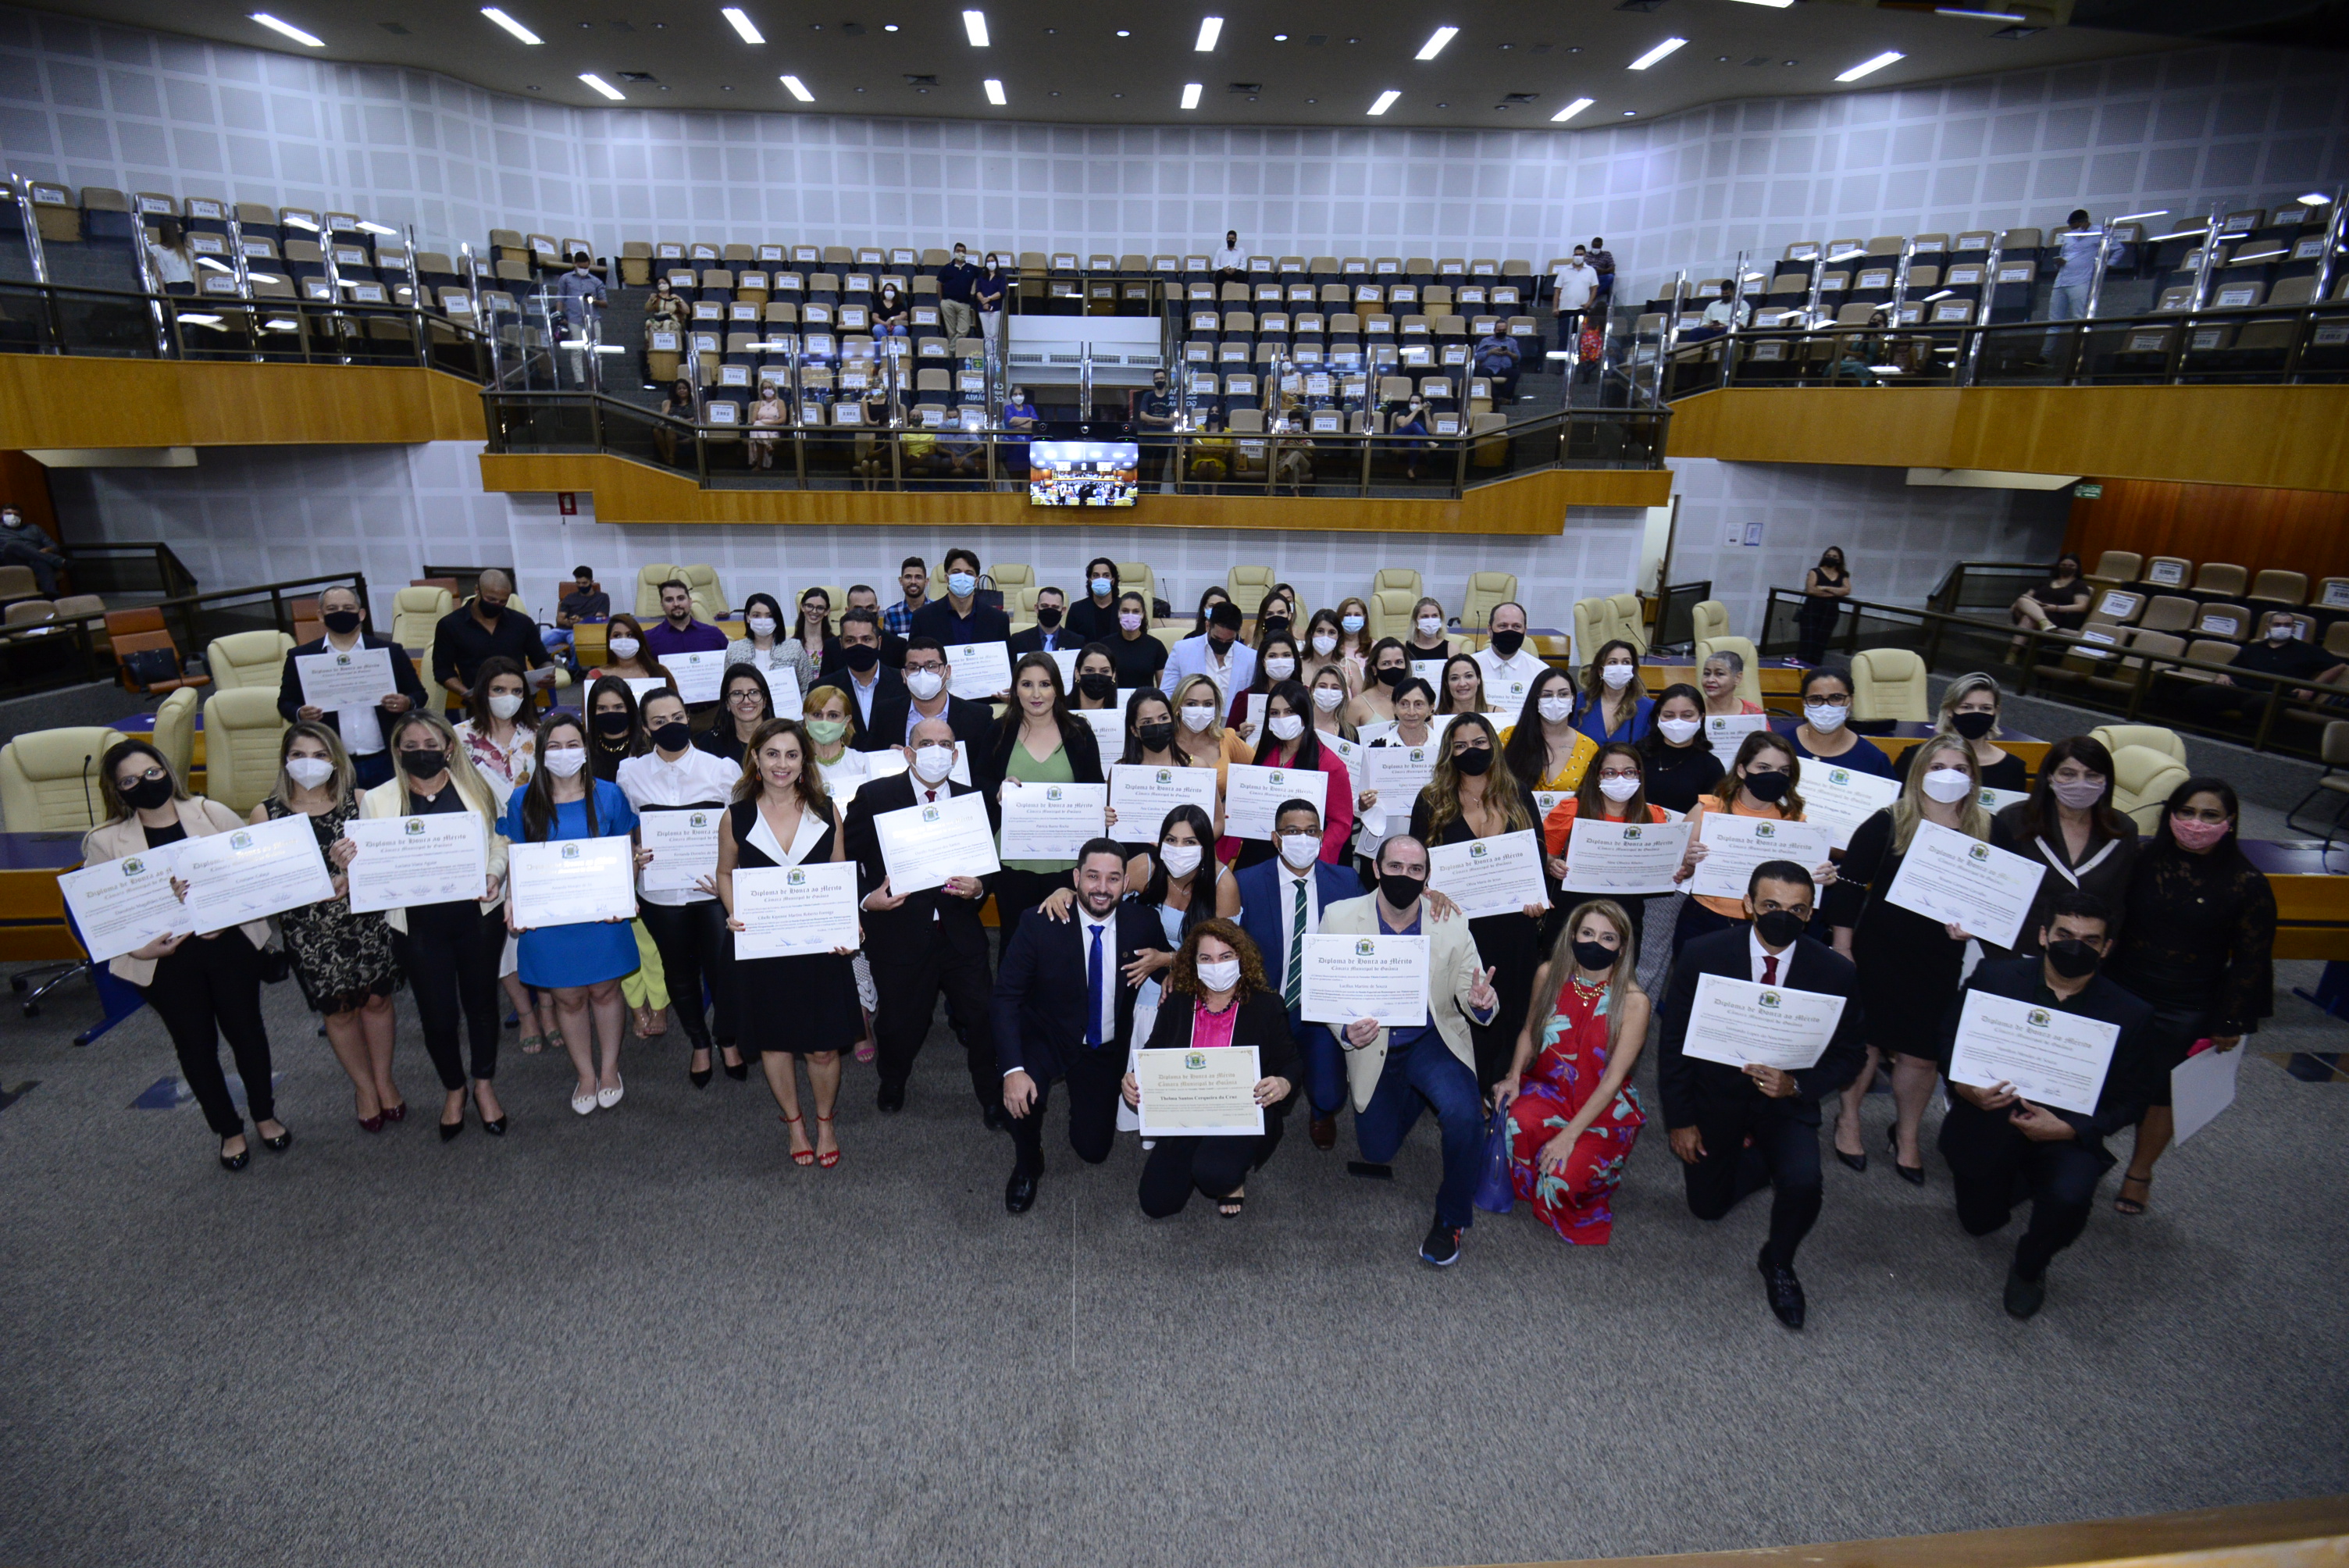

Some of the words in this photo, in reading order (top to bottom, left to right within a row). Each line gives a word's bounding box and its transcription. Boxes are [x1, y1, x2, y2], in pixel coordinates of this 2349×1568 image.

[365, 839, 396, 848] Diploma
[408, 836, 431, 844] Honra
[442, 832, 466, 842] Mérito
[1586, 838, 1613, 846] Diploma
[1716, 834, 1745, 844] Diploma
[1756, 839, 1777, 847] Honra
[1788, 842, 1812, 850] Mérito
[1439, 863, 1464, 871] Diploma
[1474, 857, 1493, 865] Honra
[1502, 852, 1523, 861] Mérito
[1928, 845, 1956, 861] Diploma
[86, 885, 118, 899] Diploma
[130, 873, 154, 885] Honra
[1714, 999, 1745, 1010] Diploma
[1758, 1007, 1782, 1018] Honra
[1794, 1014, 1820, 1024] Mérito
[1981, 1015, 2013, 1029] Diploma
[2026, 1026, 2051, 1039] Honra
[2064, 1036, 2092, 1049] Mérito
